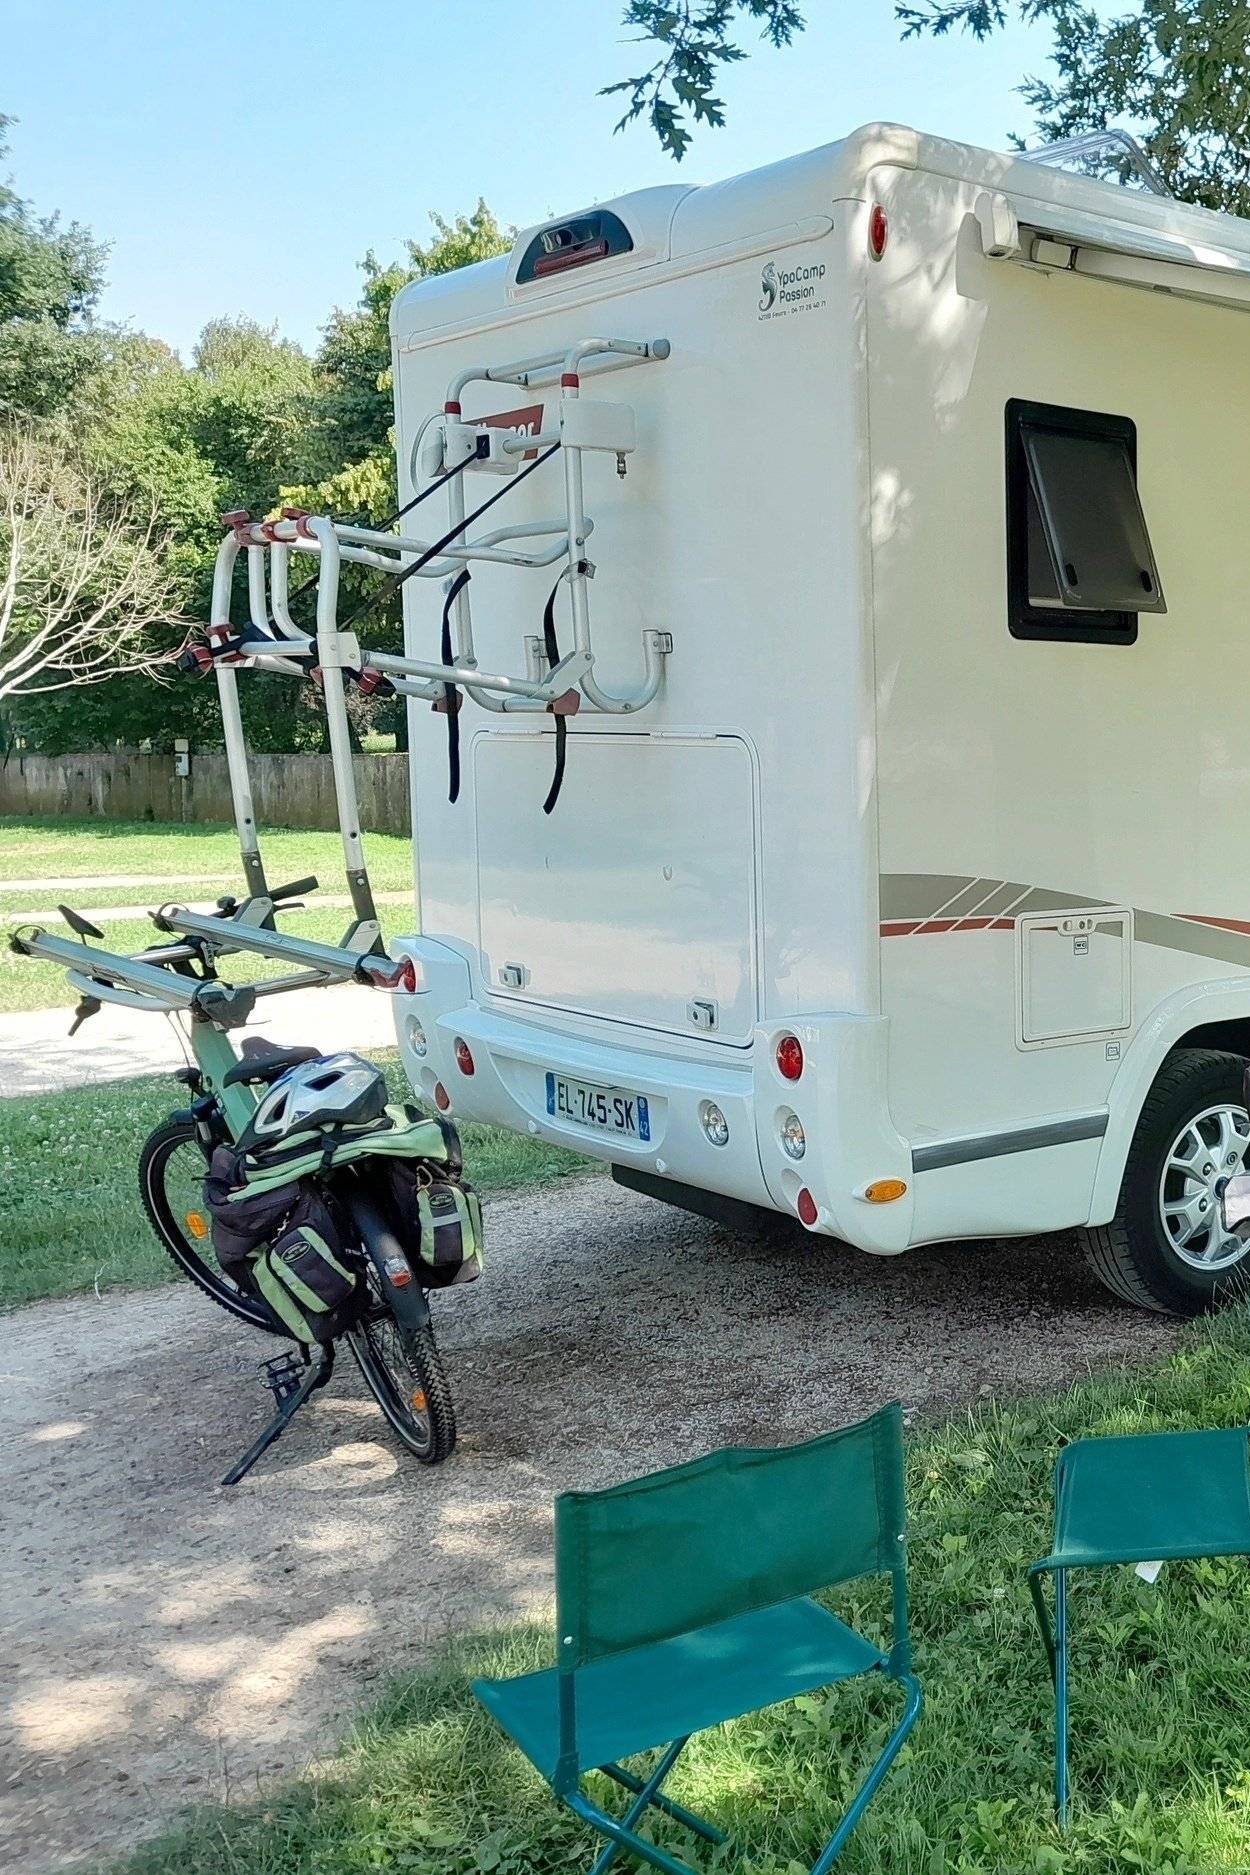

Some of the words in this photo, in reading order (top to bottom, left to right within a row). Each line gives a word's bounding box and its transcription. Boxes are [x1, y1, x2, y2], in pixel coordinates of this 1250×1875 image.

[777, 264, 826, 287] YpoCamp
[779, 286, 815, 304] Passion
[558, 1081, 636, 1131] EL-745-SK
